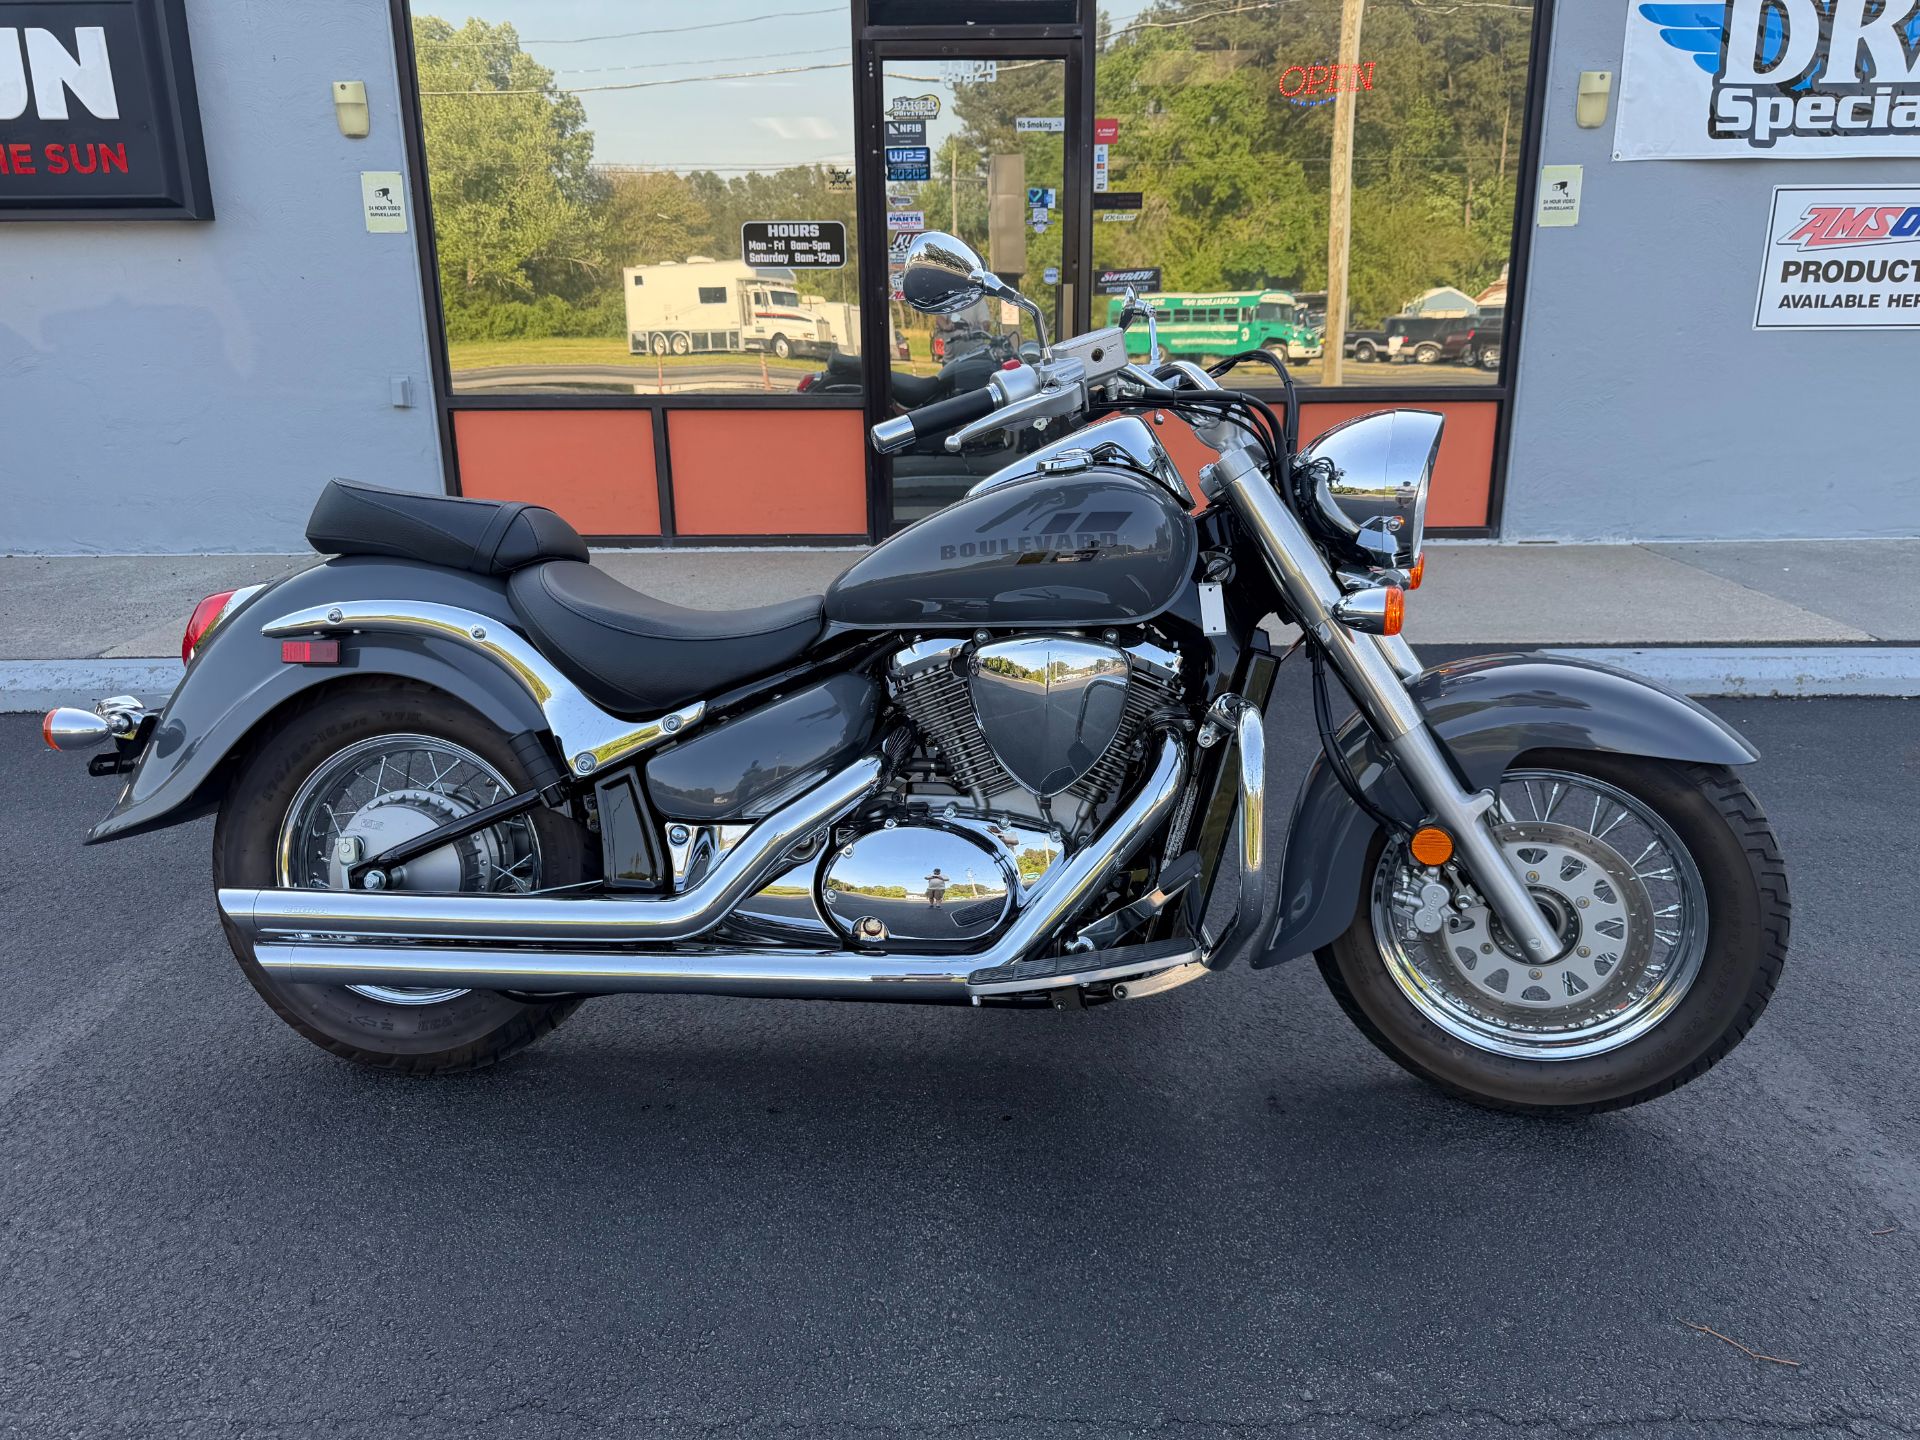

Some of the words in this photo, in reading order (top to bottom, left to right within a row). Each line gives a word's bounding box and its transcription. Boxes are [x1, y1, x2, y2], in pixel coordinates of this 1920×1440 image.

[1720, 0, 1920, 84] DR
[1279, 61, 1376, 97] OPEN
[893, 100, 937, 110] BAKER
[1716, 87, 1920, 141] Specia
[899, 123, 922, 133] NFIB
[1017, 121, 1026, 129] No
[1027, 121, 1052, 129] Smoking
[45, 143, 129, 175] SUN
[889, 150, 926, 162] WPS
[767, 224, 820, 237] HOURS
[1788, 207, 1920, 247] AMSO
[748, 240, 767, 250] Mon
[773, 240, 786, 250] Fri
[790, 240, 831, 252] 8am-5pm
[749, 252, 789, 264] Saturday
[794, 252, 841, 264] 8am-12pm
[1778, 294, 1881, 309] AVAILABLE
[940, 532, 1118, 560] BOULEVARD
